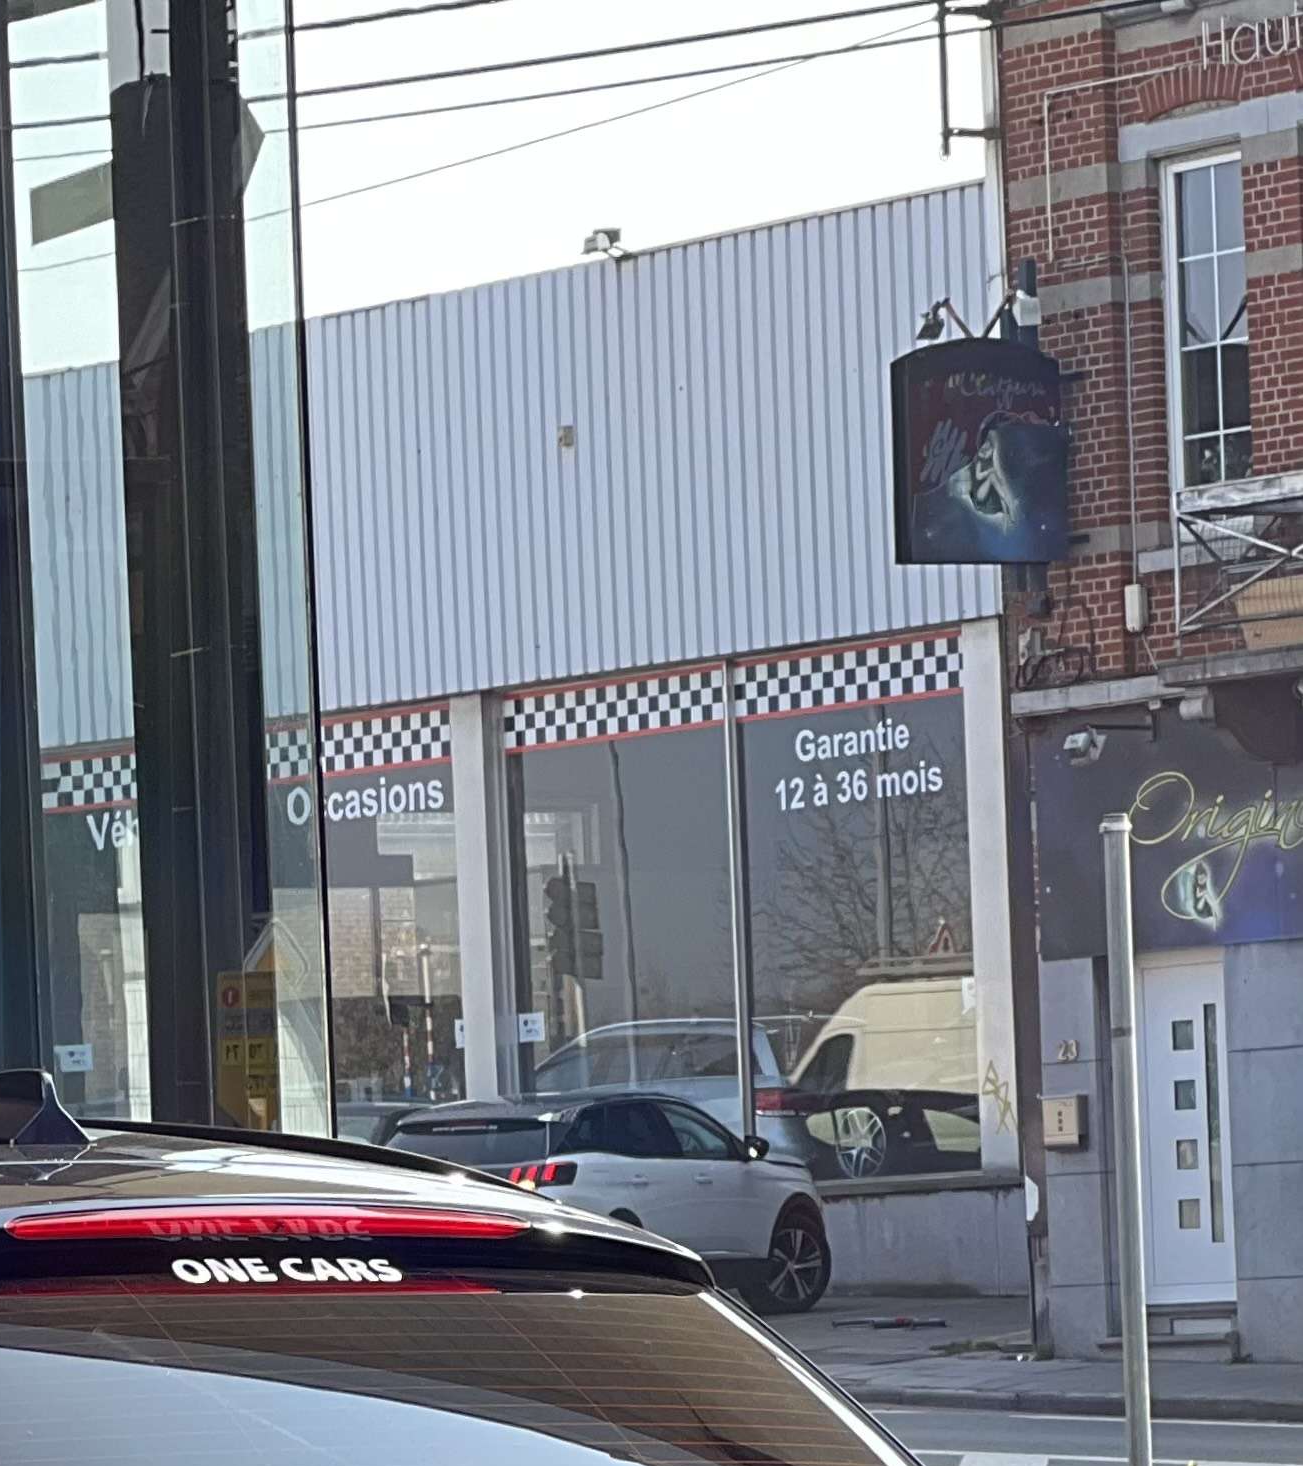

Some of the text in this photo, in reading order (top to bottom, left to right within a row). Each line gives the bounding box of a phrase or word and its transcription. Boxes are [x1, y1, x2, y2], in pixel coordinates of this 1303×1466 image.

[1201, 15, 1303, 71] Hau
[794, 717, 910, 762] Garantie
[286, 776, 445, 826] Ocasions
[775, 760, 943, 811] 12 à 36 mois
[171, 1256, 403, 1284] ONE CARS
